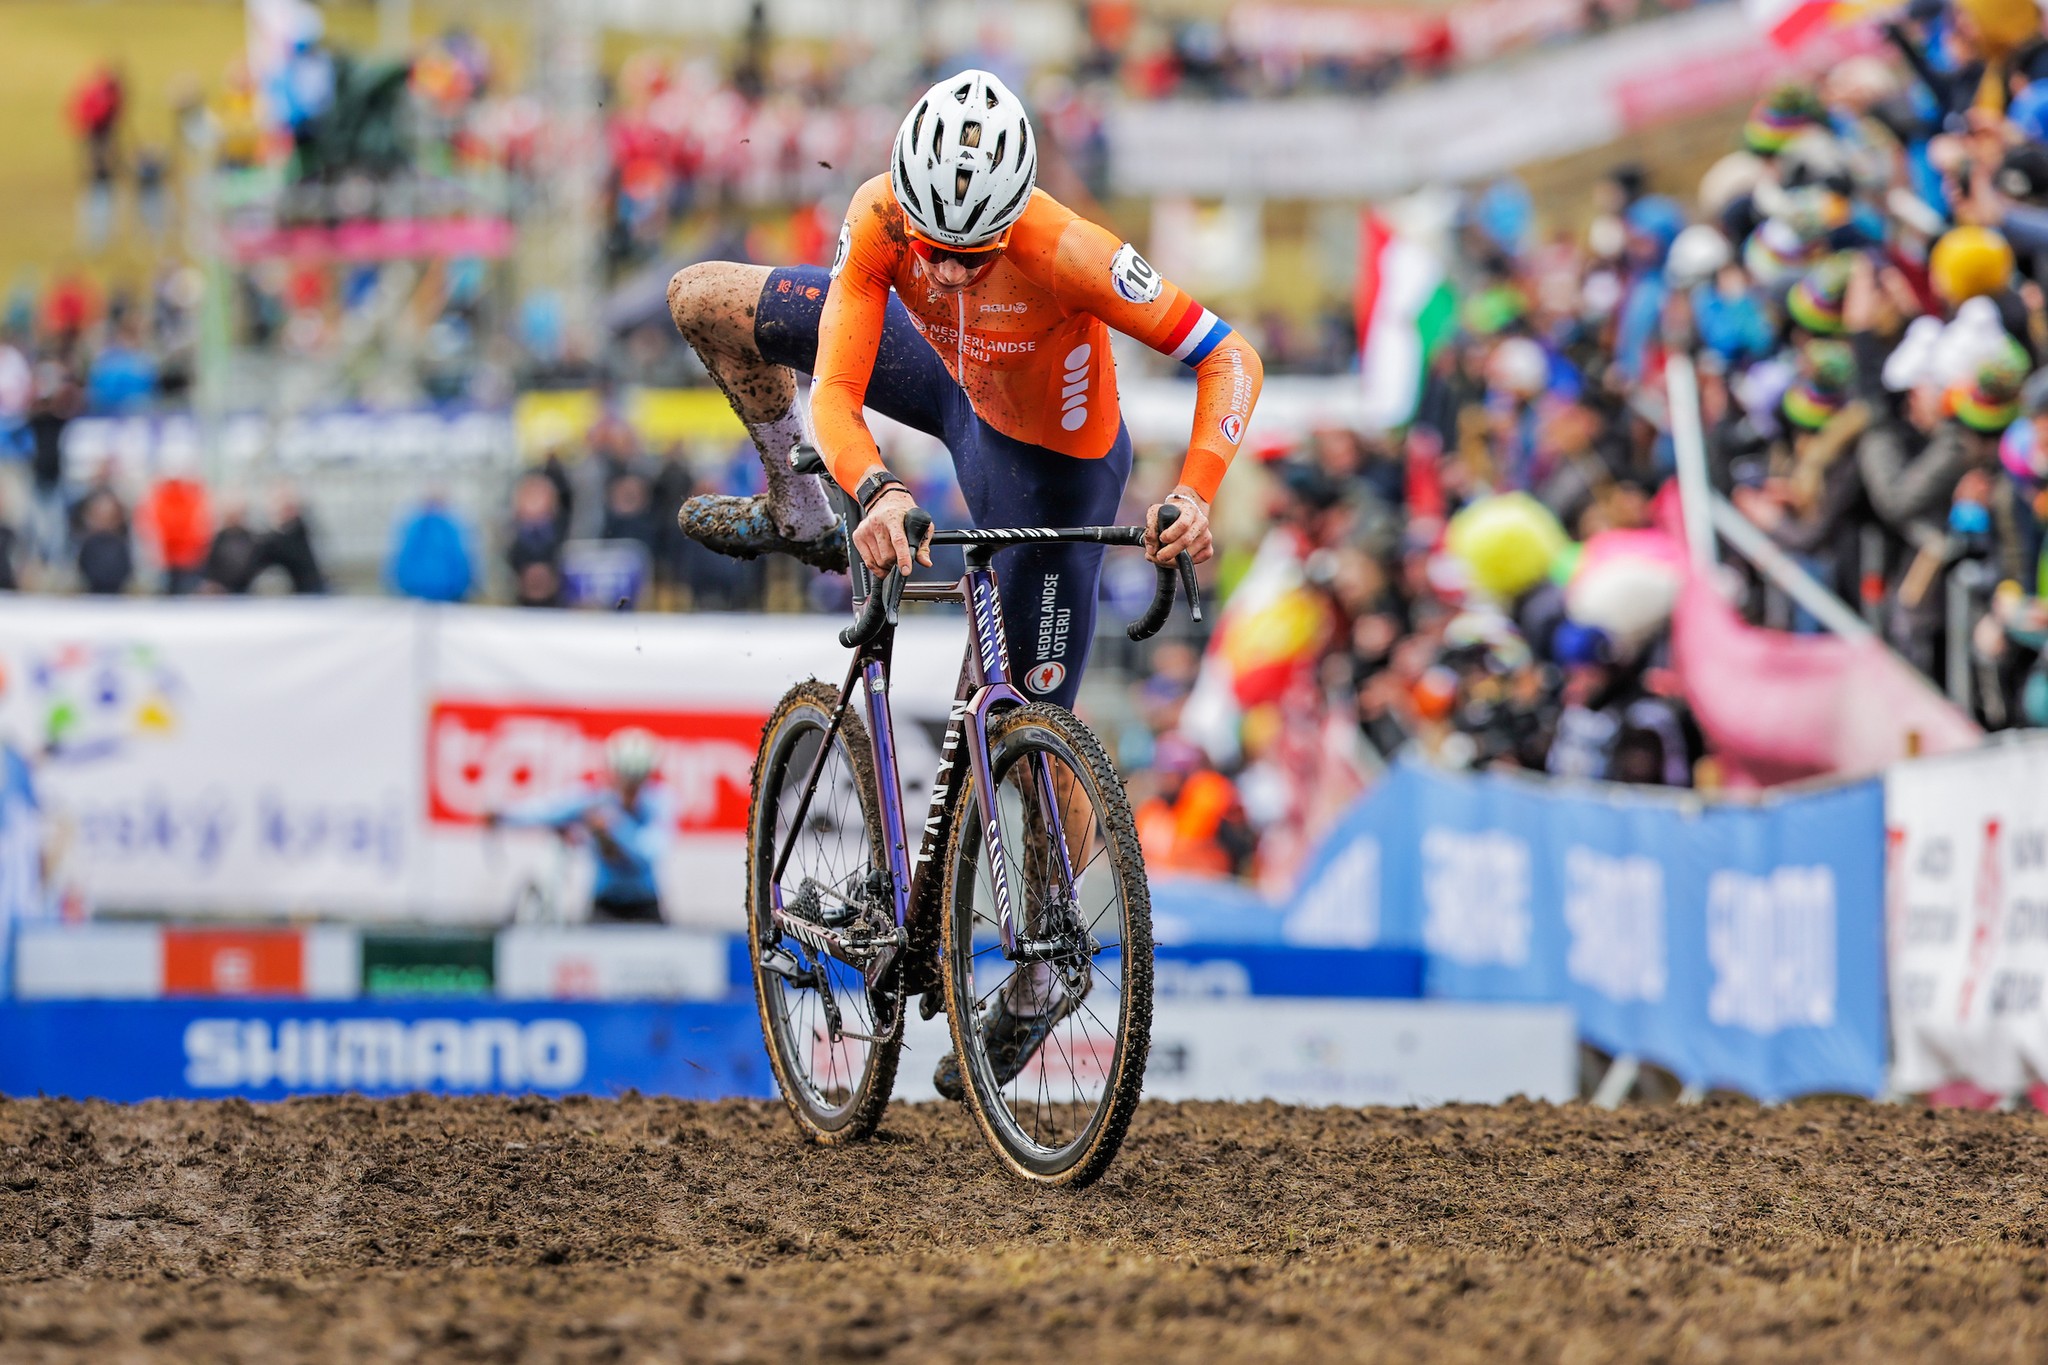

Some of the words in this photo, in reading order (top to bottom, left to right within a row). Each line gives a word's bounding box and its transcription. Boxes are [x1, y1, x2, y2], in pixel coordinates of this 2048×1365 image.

[940, 232, 965, 242] CANYON
[1126, 255, 1152, 290] 10
[980, 303, 1012, 312] AGU
[929, 332, 990, 362] LOTERIJ
[930, 324, 1036, 353] NEDERLANDSE
[1240, 374, 1253, 418] LOTERIJ
[973, 584, 996, 673] CANYON
[989, 586, 1009, 671] CANYON
[1036, 573, 1059, 660] NEDERLANDSE
[1052, 608, 1071, 658] LOTERIJ
[986, 819, 1011, 929] CANYON
[184, 1018, 587, 1088] SHIMANO
